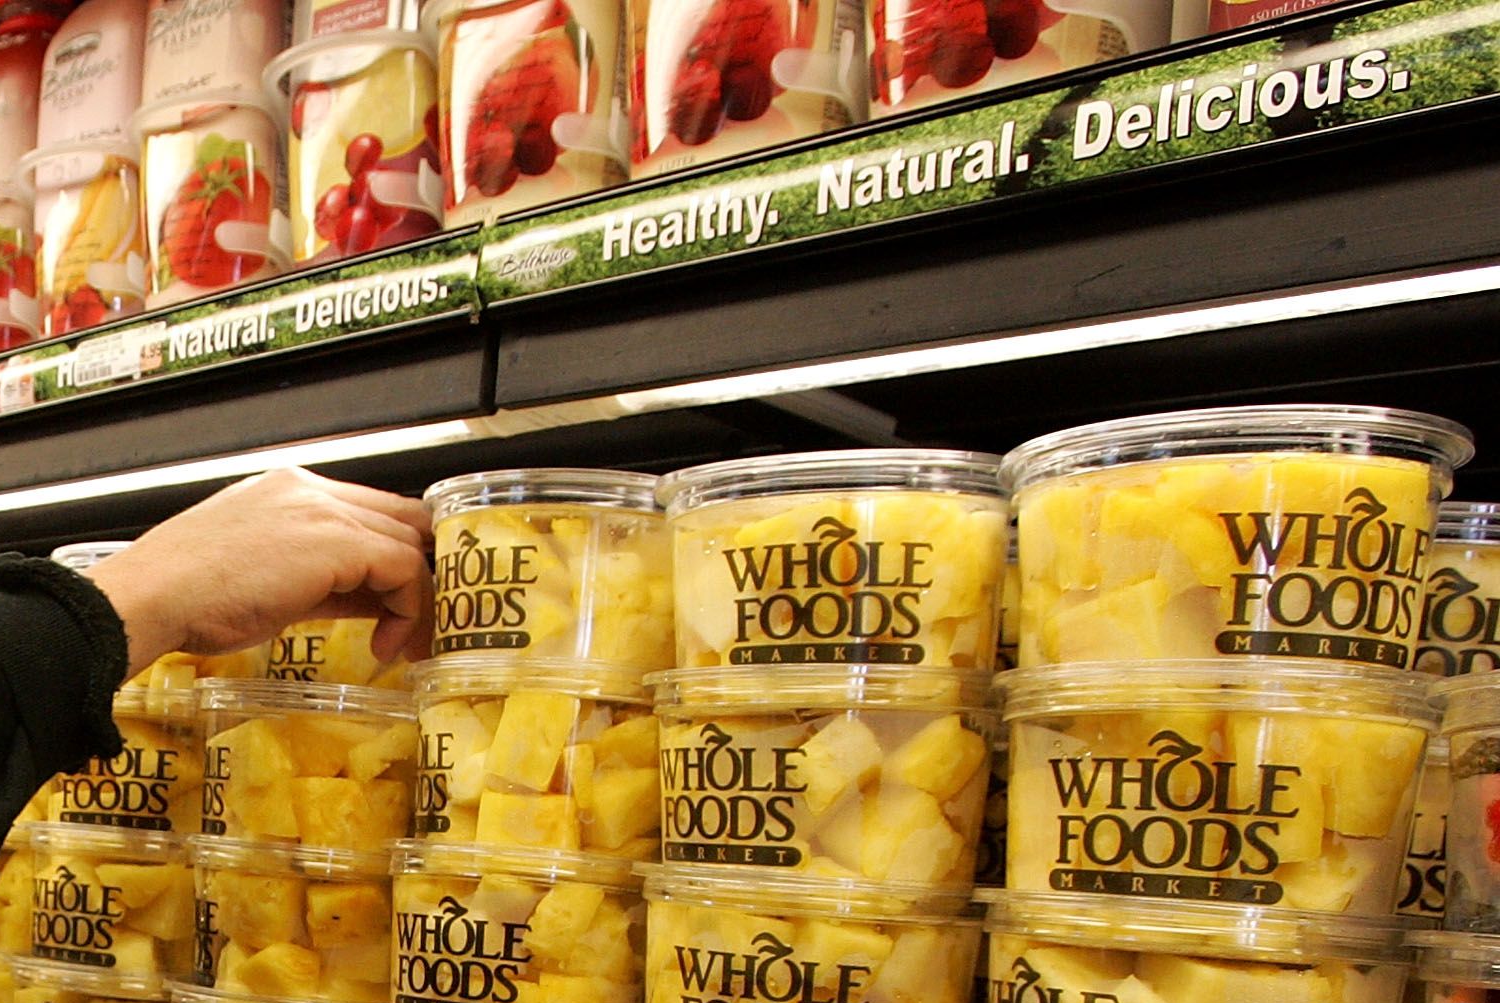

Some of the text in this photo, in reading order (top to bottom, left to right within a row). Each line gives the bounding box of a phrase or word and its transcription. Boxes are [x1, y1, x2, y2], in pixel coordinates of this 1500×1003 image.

[601, 48, 1411, 263] Healthy. Natural. Delicious.
[169, 306, 276, 362] Natural.
[295, 271, 449, 333] Delicious.
[722, 530, 934, 593] WHOLE
[1219, 500, 1430, 581] WHOLE
[734, 591, 922, 642] FOODS
[1227, 572, 1416, 639] FOODS
[736, 644, 920, 664] MARKET
[1224, 632, 1406, 667] MARKET
[660, 736, 808, 794] WHOLE
[1048, 746, 1302, 819] WHOLE
[62, 778, 170, 815] FOODS
[665, 796, 796, 842] FOODS
[1056, 815, 1281, 876] FOODS
[1054, 869, 1273, 903] MARKET
[397, 904, 532, 963] WHOLE
[397, 954, 520, 1003] FOODS
